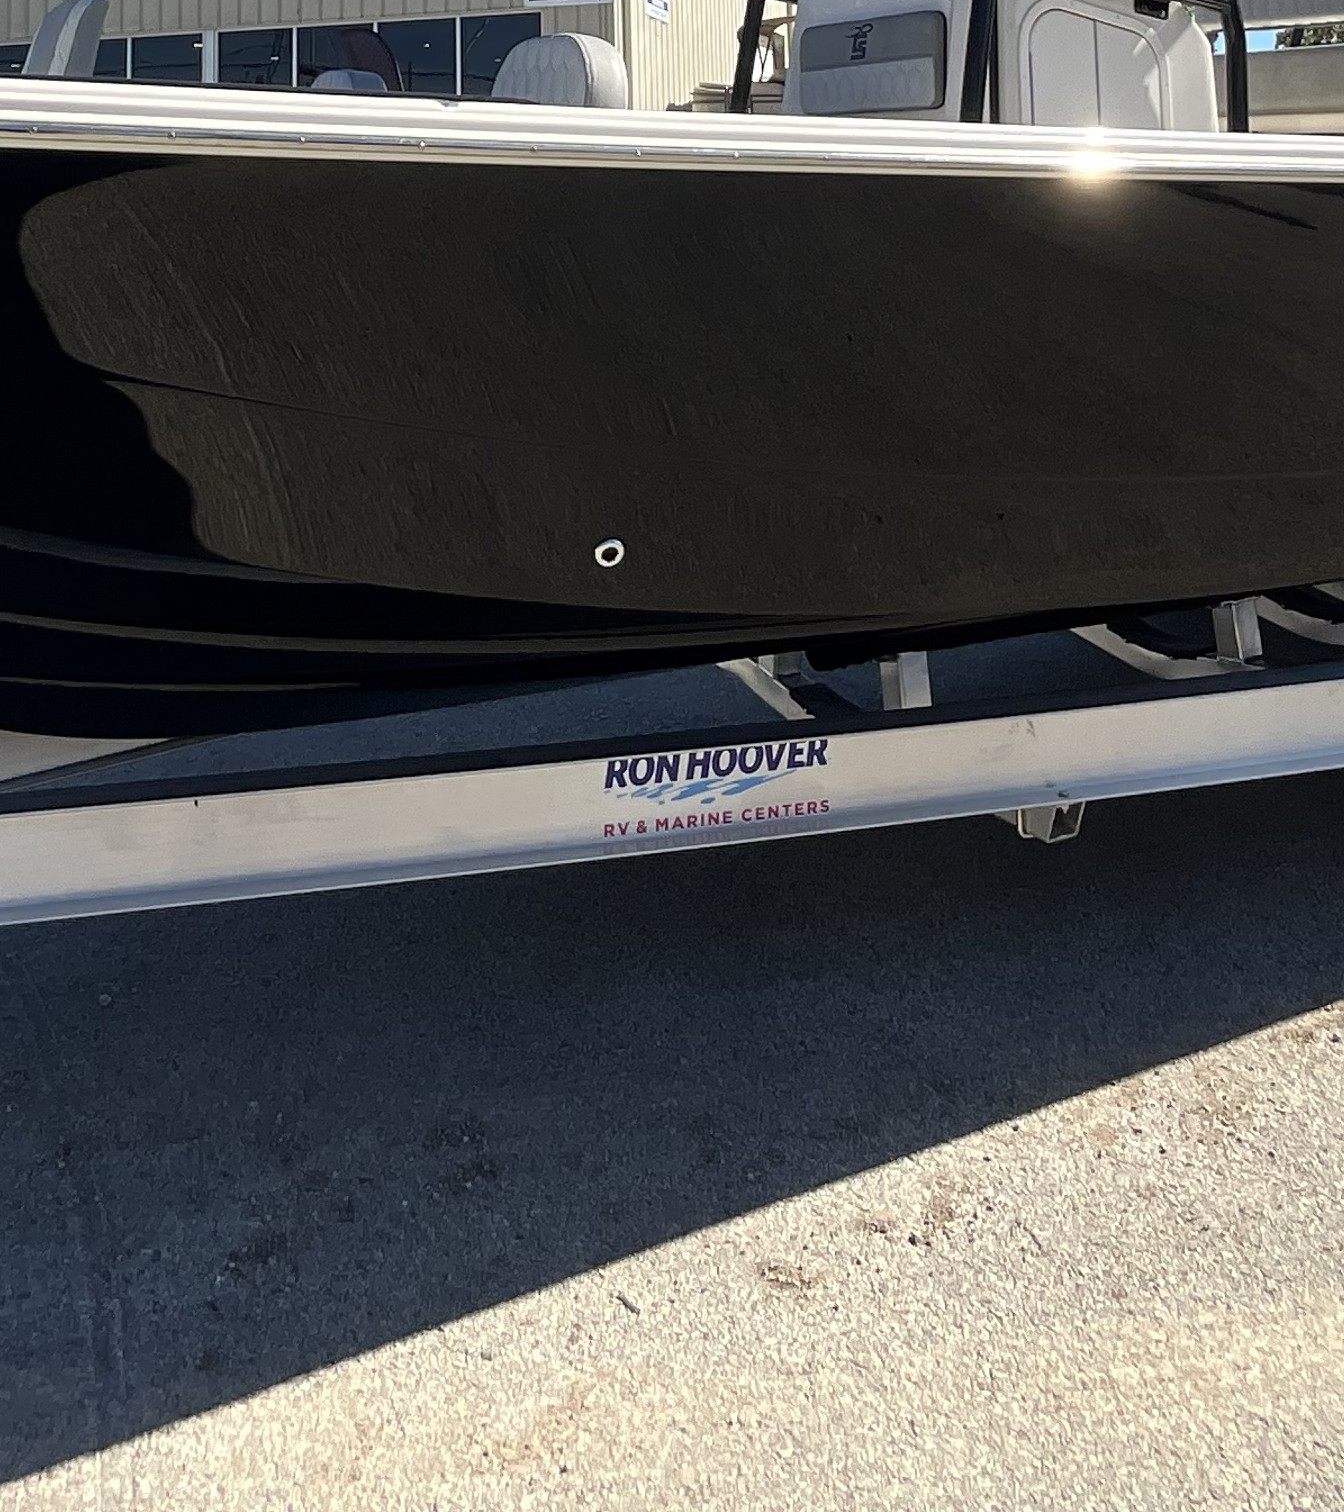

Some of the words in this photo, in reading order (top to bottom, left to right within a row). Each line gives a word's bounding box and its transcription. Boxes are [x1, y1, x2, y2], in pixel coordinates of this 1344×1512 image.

[605, 753, 680, 789] RON
[686, 739, 829, 780] HOOVER
[604, 821, 630, 838] RV
[636, 819, 649, 834] &
[656, 810, 733, 832] MARINE
[741, 800, 831, 823] CENTERS
